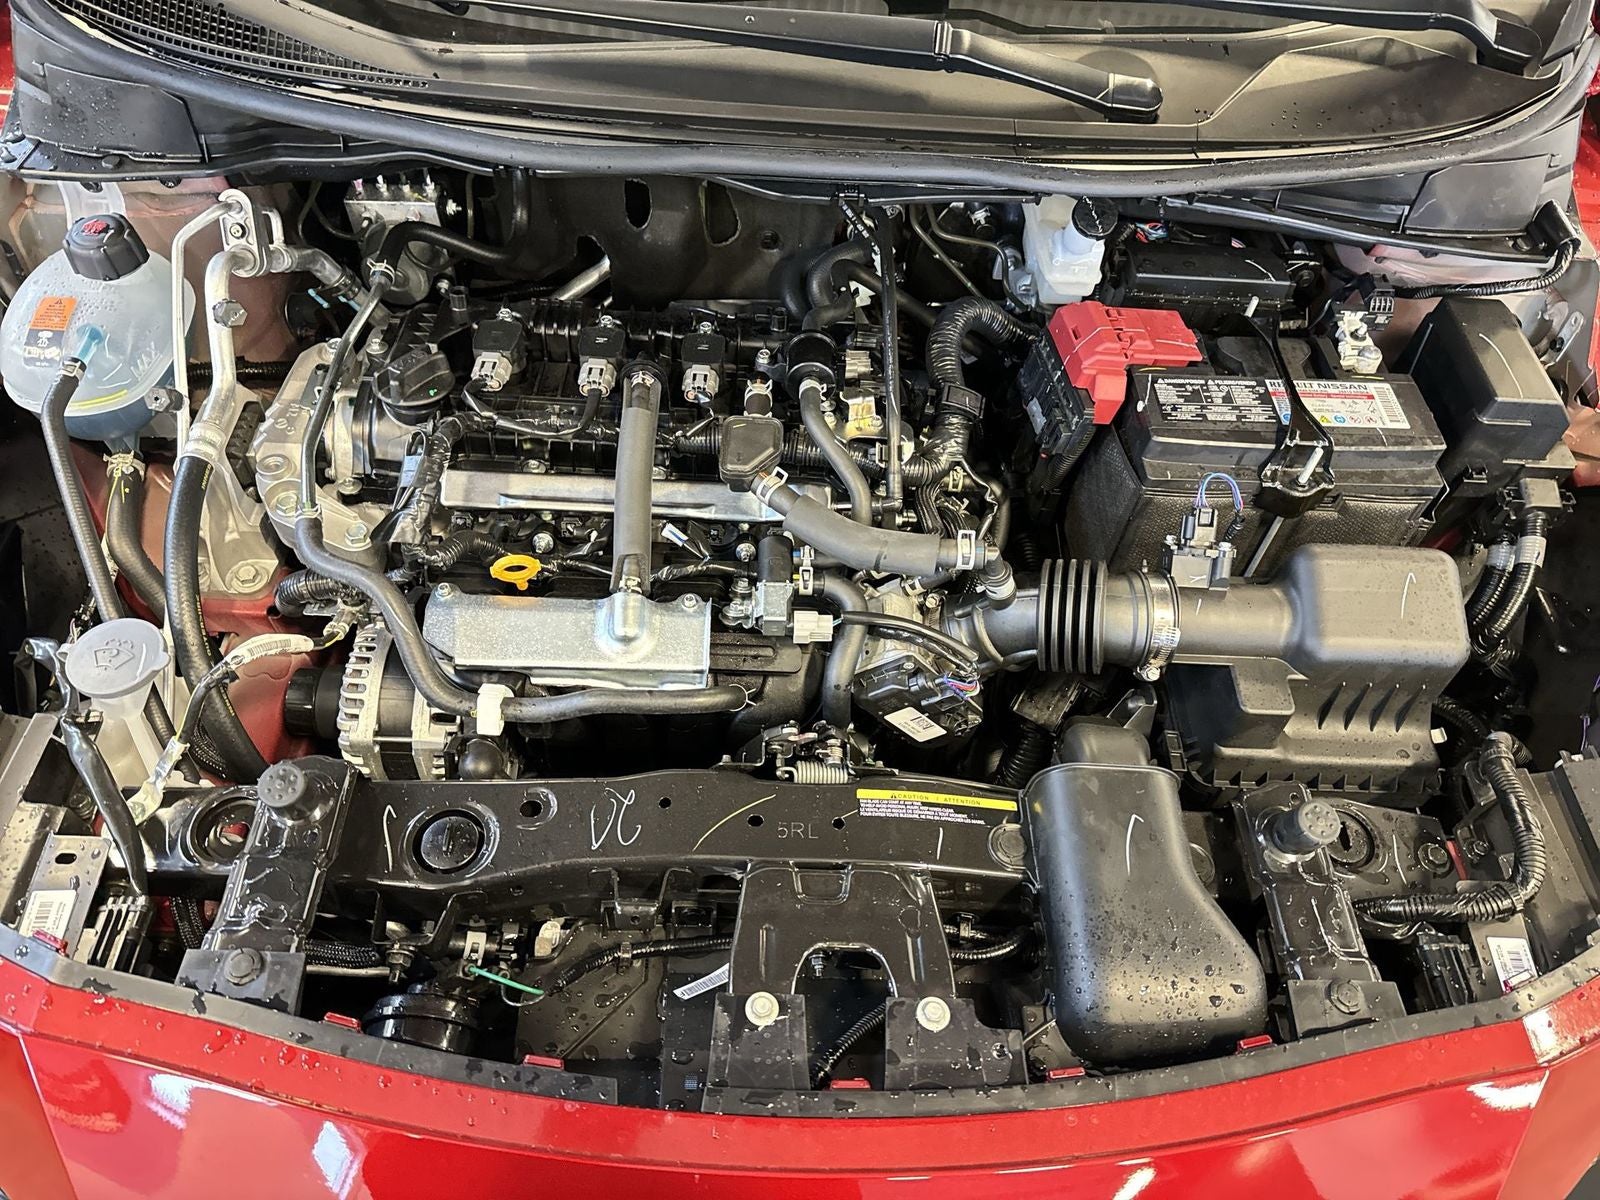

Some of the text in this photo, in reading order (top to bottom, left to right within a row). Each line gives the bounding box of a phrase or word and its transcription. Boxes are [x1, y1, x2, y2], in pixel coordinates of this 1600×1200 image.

[1269, 381, 1314, 389] REULT
[1317, 382, 1368, 390] NISSAN
[944, 797, 981, 805] ATTENTION
[777, 821, 819, 839] 5RL
